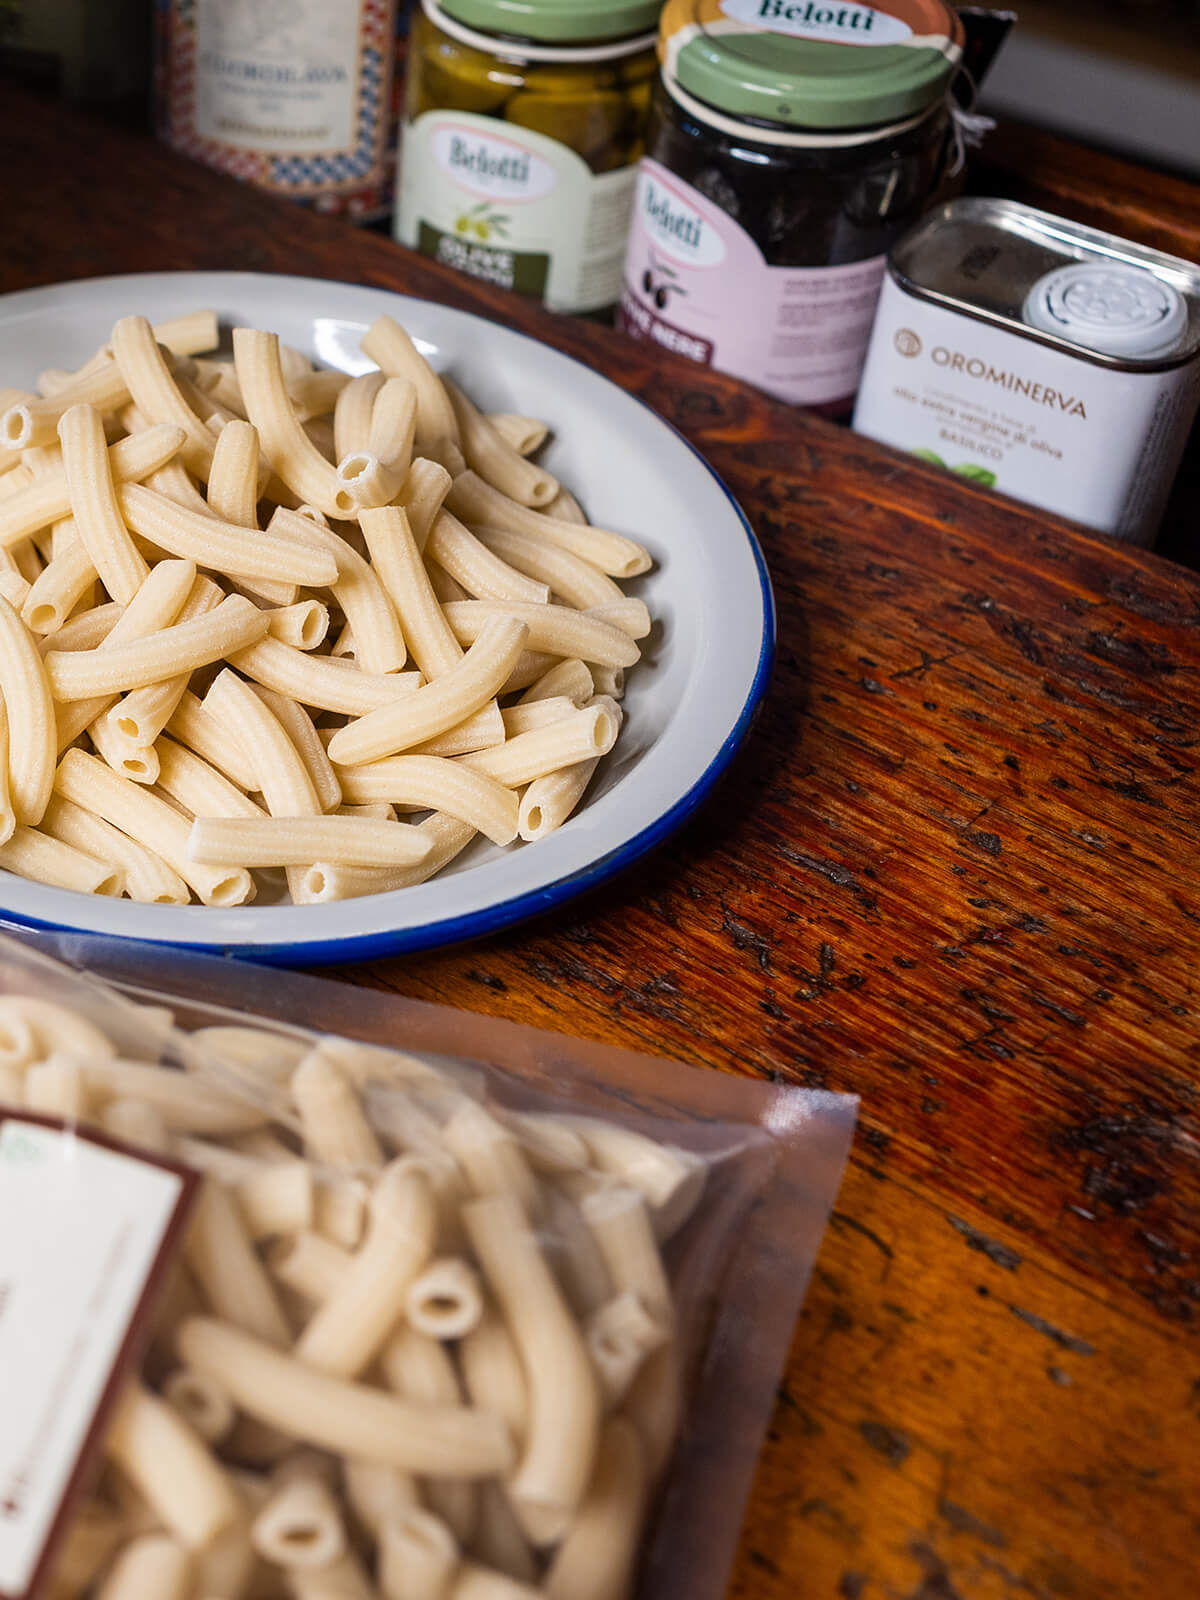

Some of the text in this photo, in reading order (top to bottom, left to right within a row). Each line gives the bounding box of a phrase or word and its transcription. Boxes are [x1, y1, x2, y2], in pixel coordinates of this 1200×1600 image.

[759, 0, 874, 31] Belotti
[449, 135, 530, 183] Belotti
[931, 346, 1087, 420] OROMINERVA
